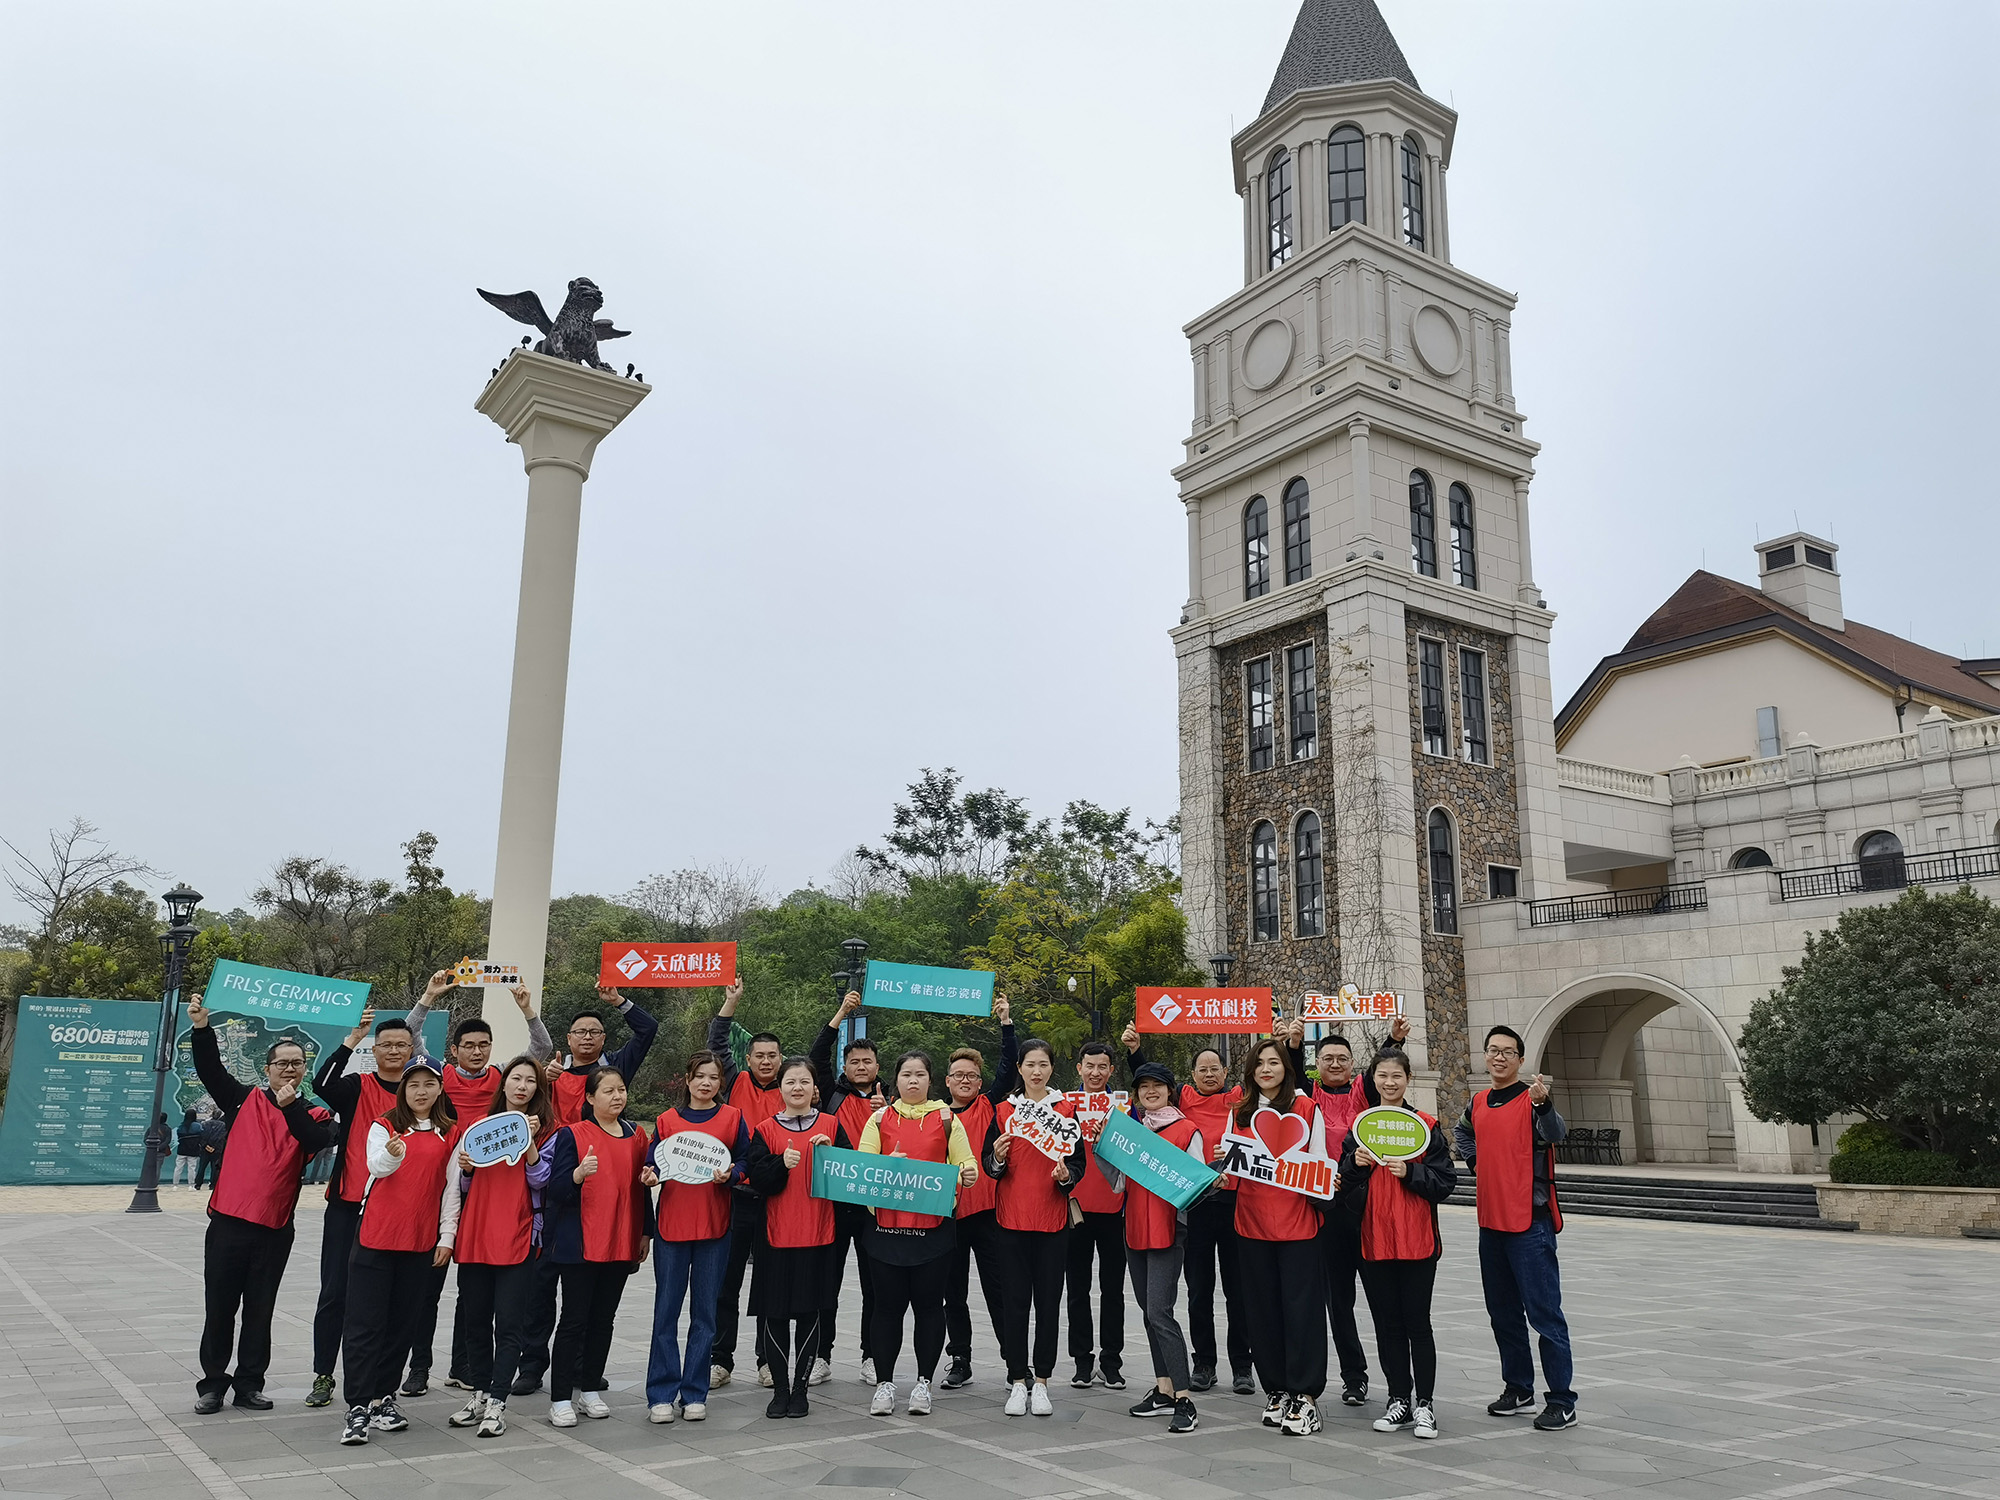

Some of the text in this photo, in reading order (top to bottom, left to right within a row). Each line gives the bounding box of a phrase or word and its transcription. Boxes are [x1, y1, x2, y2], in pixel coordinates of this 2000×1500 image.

[484, 965, 519, 974] 努力工作
[651, 952, 722, 972] 天欣科技
[223, 973, 353, 1006] FRLS CERAMICS
[874, 979, 982, 1000] FRLS 佛诺伦莎瓷砖
[247, 995, 322, 1014] 佛诺伦莎瓷砖
[1185, 998, 1258, 1018] 天欣科技
[50, 1026, 118, 1045] 6800亩
[118, 1029, 150, 1039] 中国特色
[415, 1054, 427, 1065] LA
[1068, 1092, 1110, 1113] 王牌
[474, 1121, 520, 1146] 沉迷于工作
[1367, 1119, 1415, 1132] 一直被模仿
[482, 1135, 519, 1156] 无法自拔
[676, 1135, 726, 1156] 我们的每一分钟
[1110, 1131, 1137, 1155] FRLS
[672, 1146, 722, 1167] 都是提高效率的
[694, 1164, 713, 1178] 能量
[823, 1159, 943, 1192] FRLS CERAMICS
[1220, 1139, 1332, 1196] 不忘初心
[846, 1182, 915, 1201] 佛诺伦莎瓷砖
